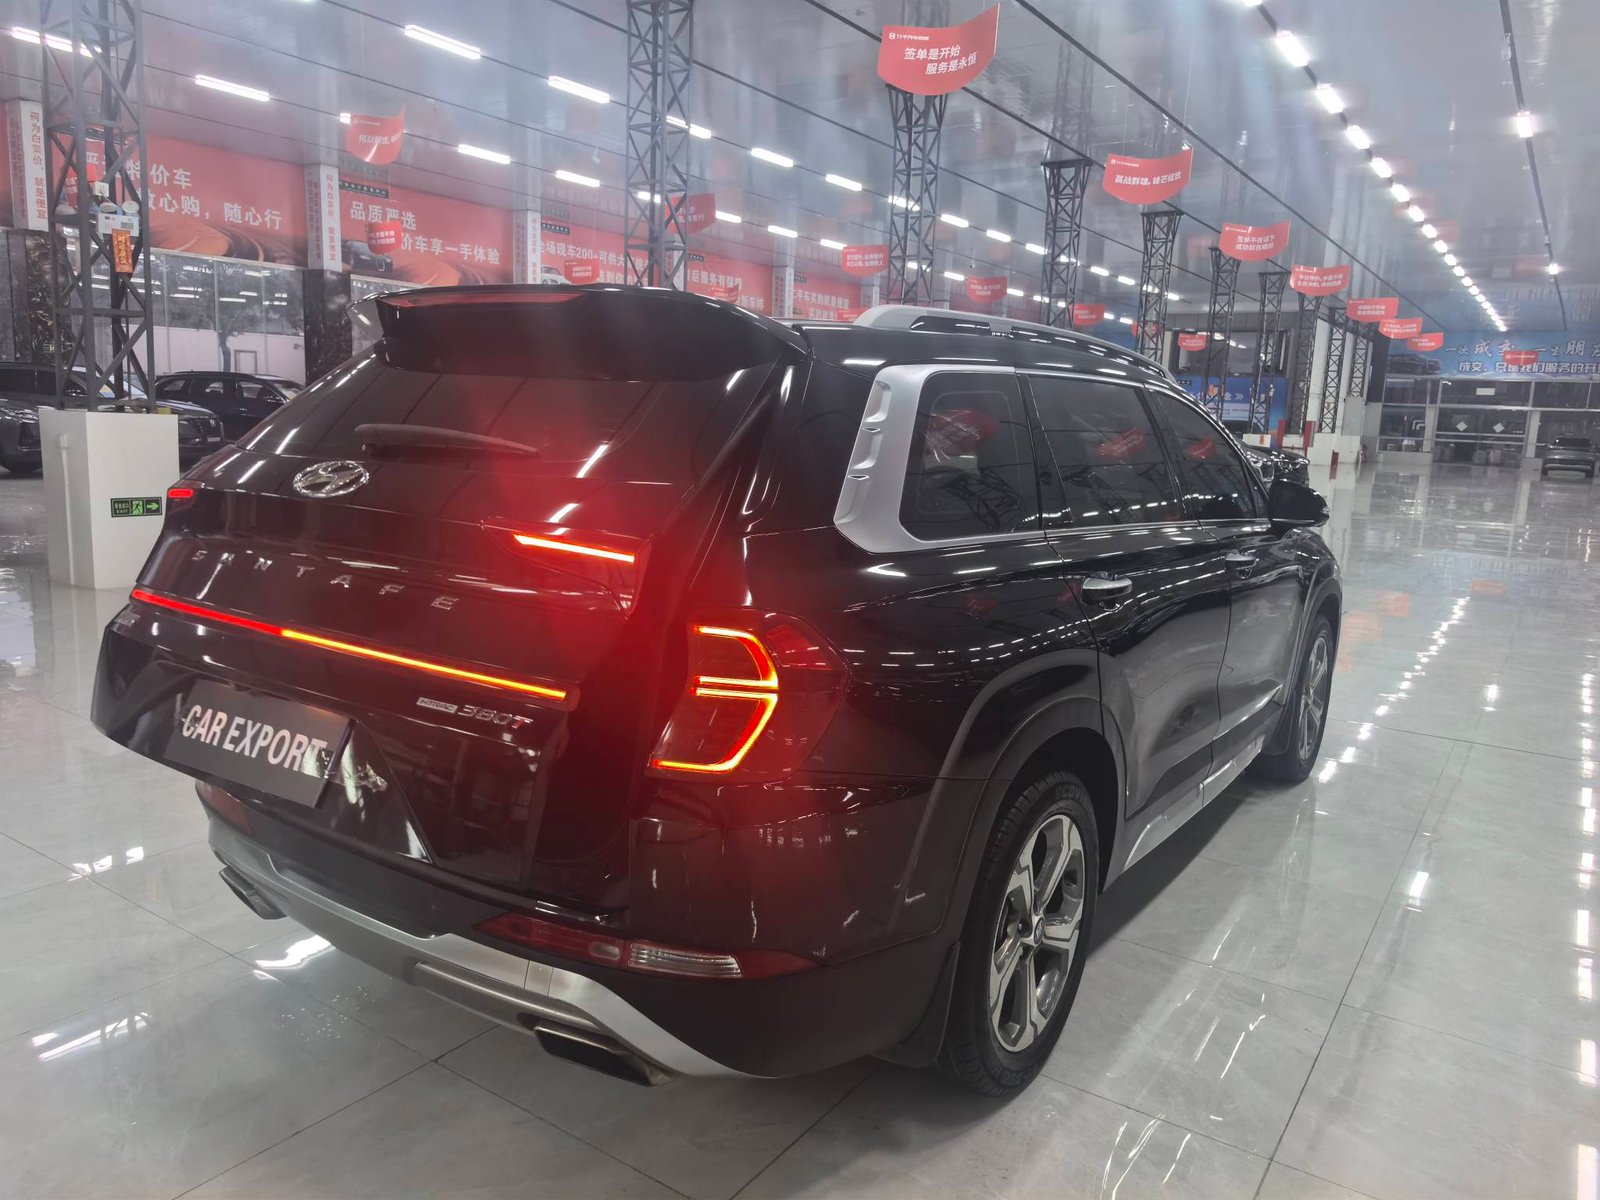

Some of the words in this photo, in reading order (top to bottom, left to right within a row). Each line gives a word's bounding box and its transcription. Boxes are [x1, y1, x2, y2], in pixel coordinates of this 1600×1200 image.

[904, 45, 961, 60] 签单是开始
[925, 52, 977, 75] 服务是永恒
[351, 201, 416, 231] 品质严选
[457, 704, 534, 728] 380T
[182, 704, 228, 746] CAR
[222, 716, 328, 773] EXPORT
